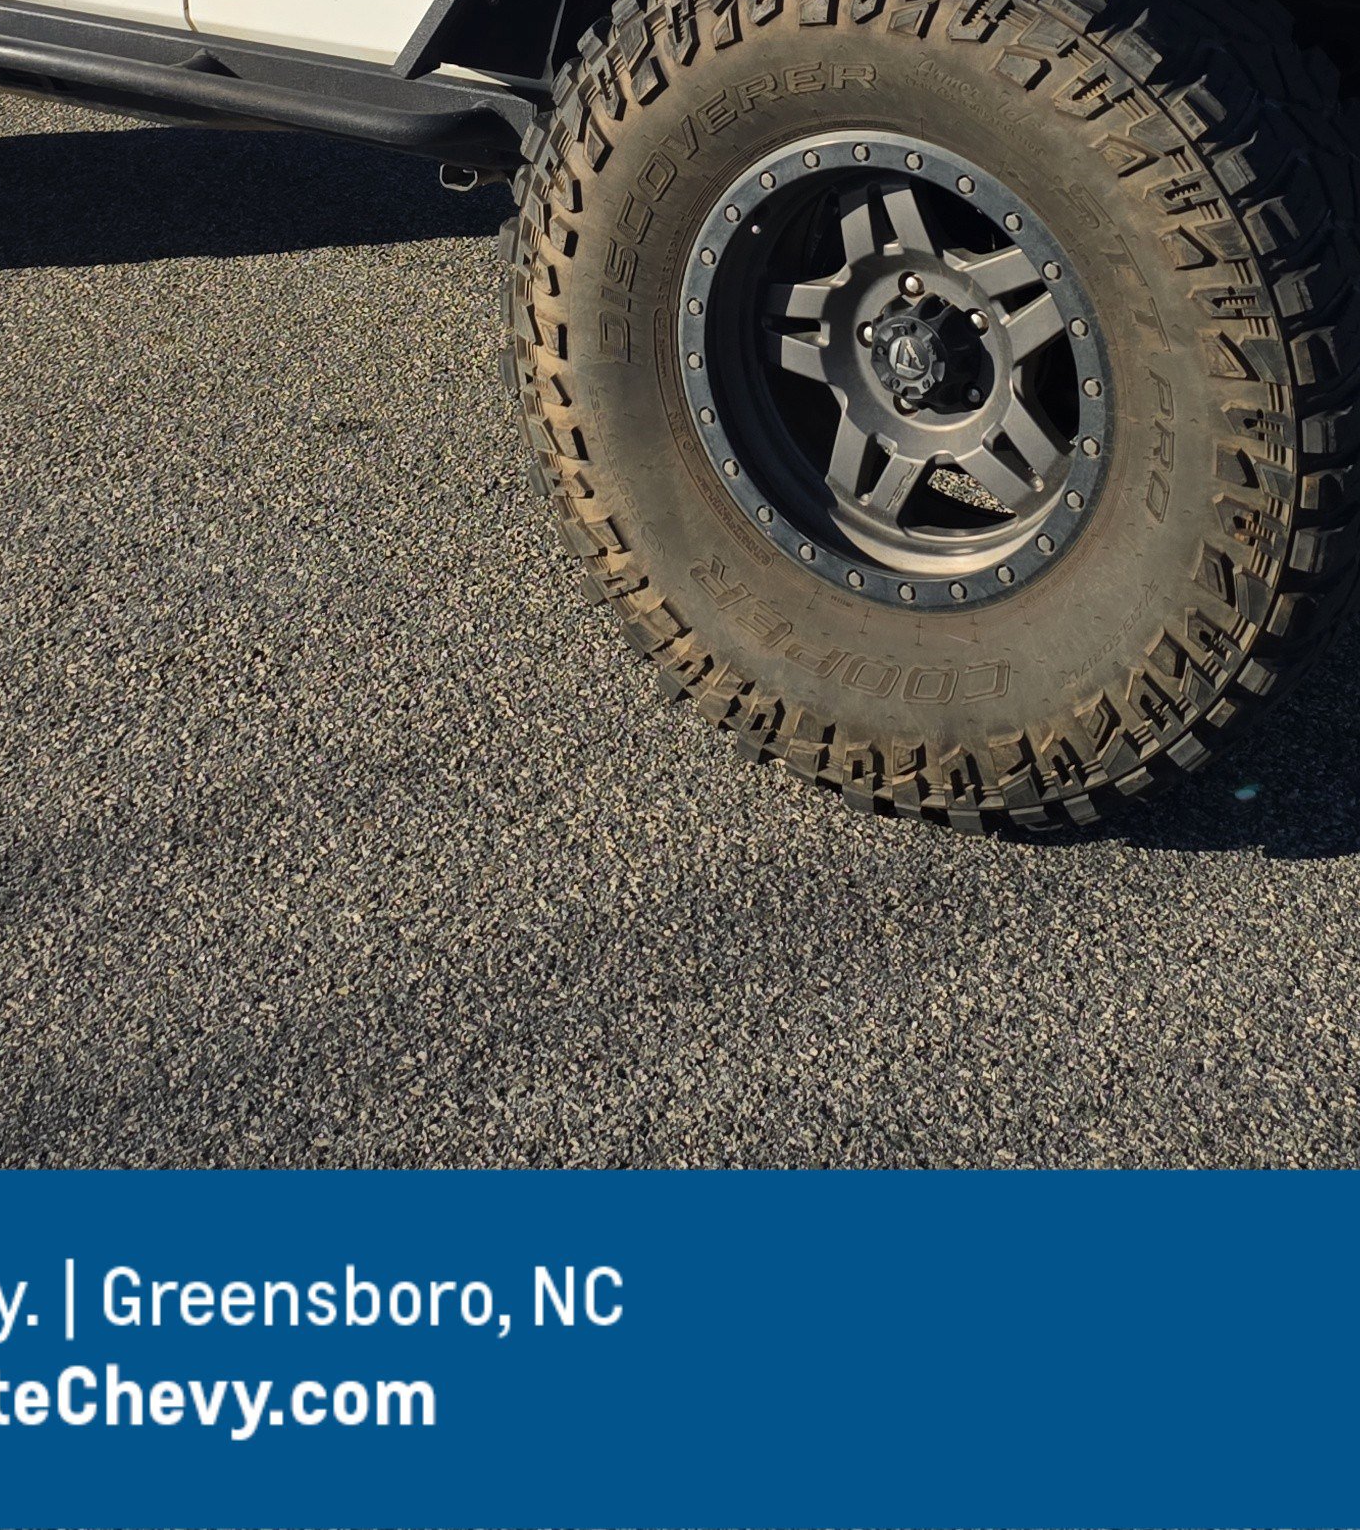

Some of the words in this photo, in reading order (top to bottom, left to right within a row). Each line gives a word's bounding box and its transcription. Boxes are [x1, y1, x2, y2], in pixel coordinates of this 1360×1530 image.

[598, 60, 878, 364] DISCOVERER
[1142, 367, 1175, 523] PRO
[690, 554, 1011, 705] COOPER
